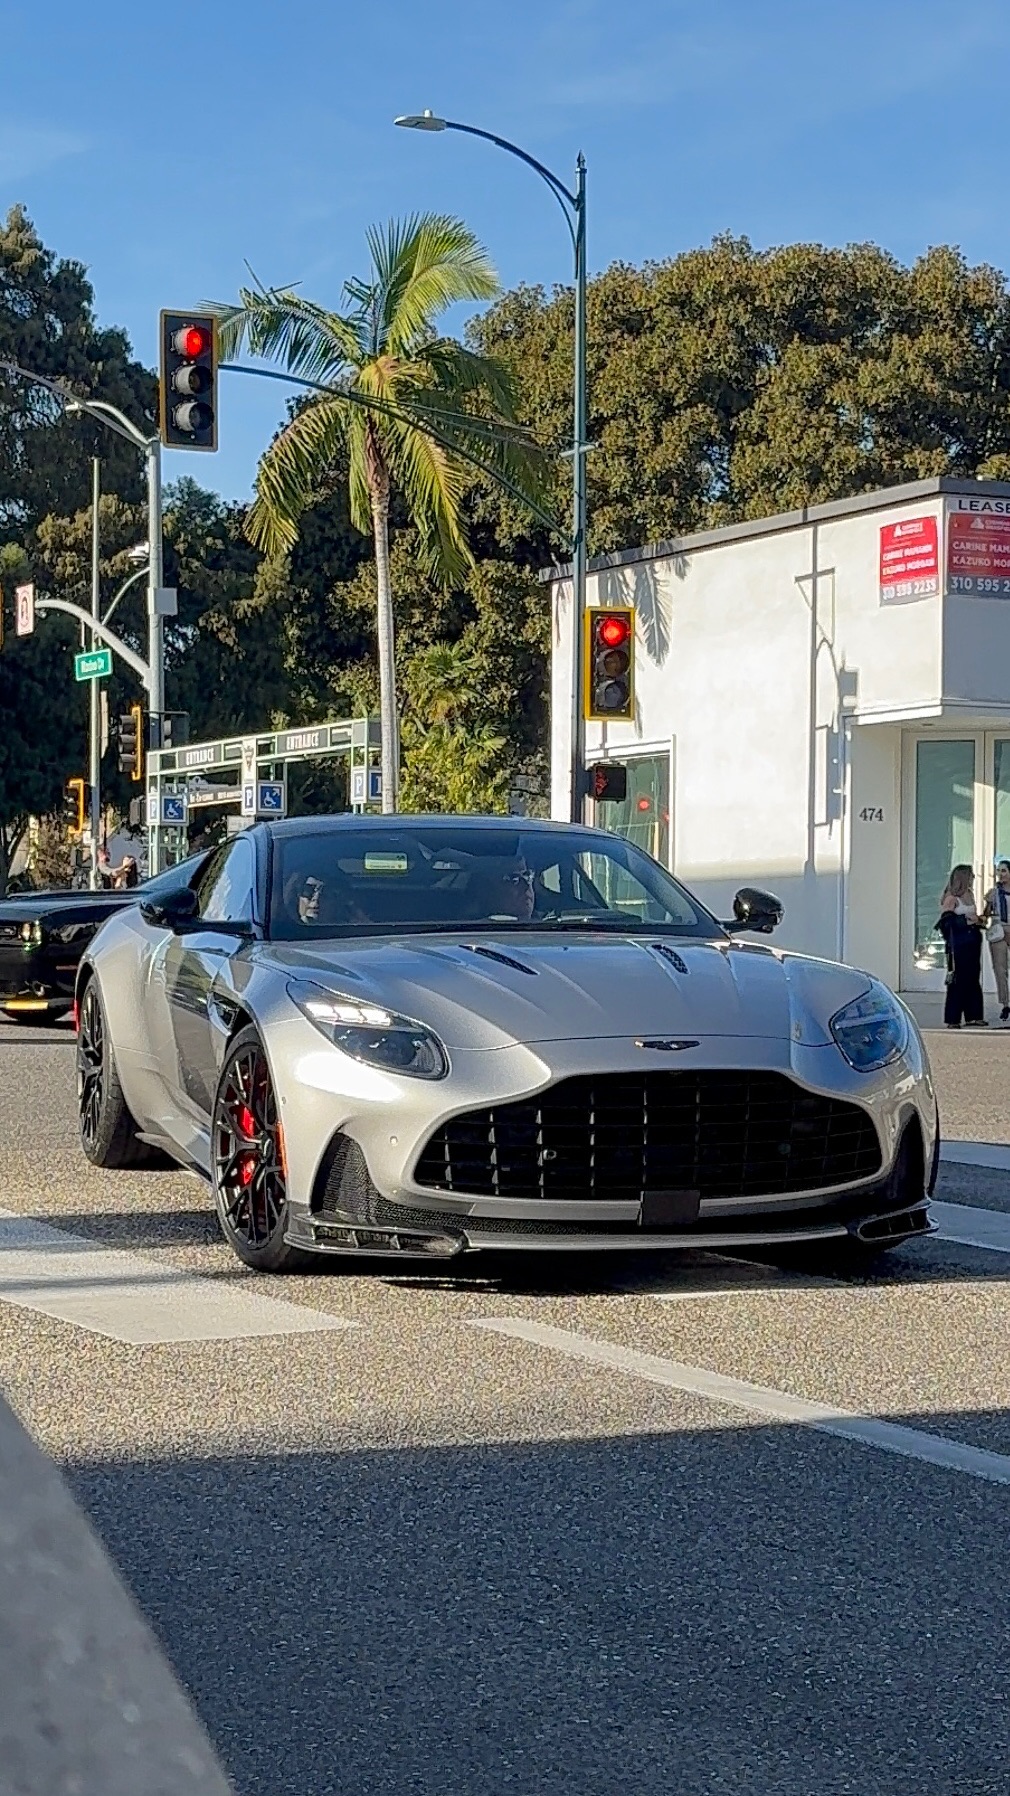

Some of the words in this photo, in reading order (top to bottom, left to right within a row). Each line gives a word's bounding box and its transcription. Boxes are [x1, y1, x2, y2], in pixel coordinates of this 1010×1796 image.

[951, 576, 973, 590] 310
[976, 578, 1000, 592] 595
[286, 732, 319, 750] ENTRANCE
[186, 747, 215, 766] ENTRANCE
[246, 789, 253, 806] P
[859, 807, 884, 822] 474
